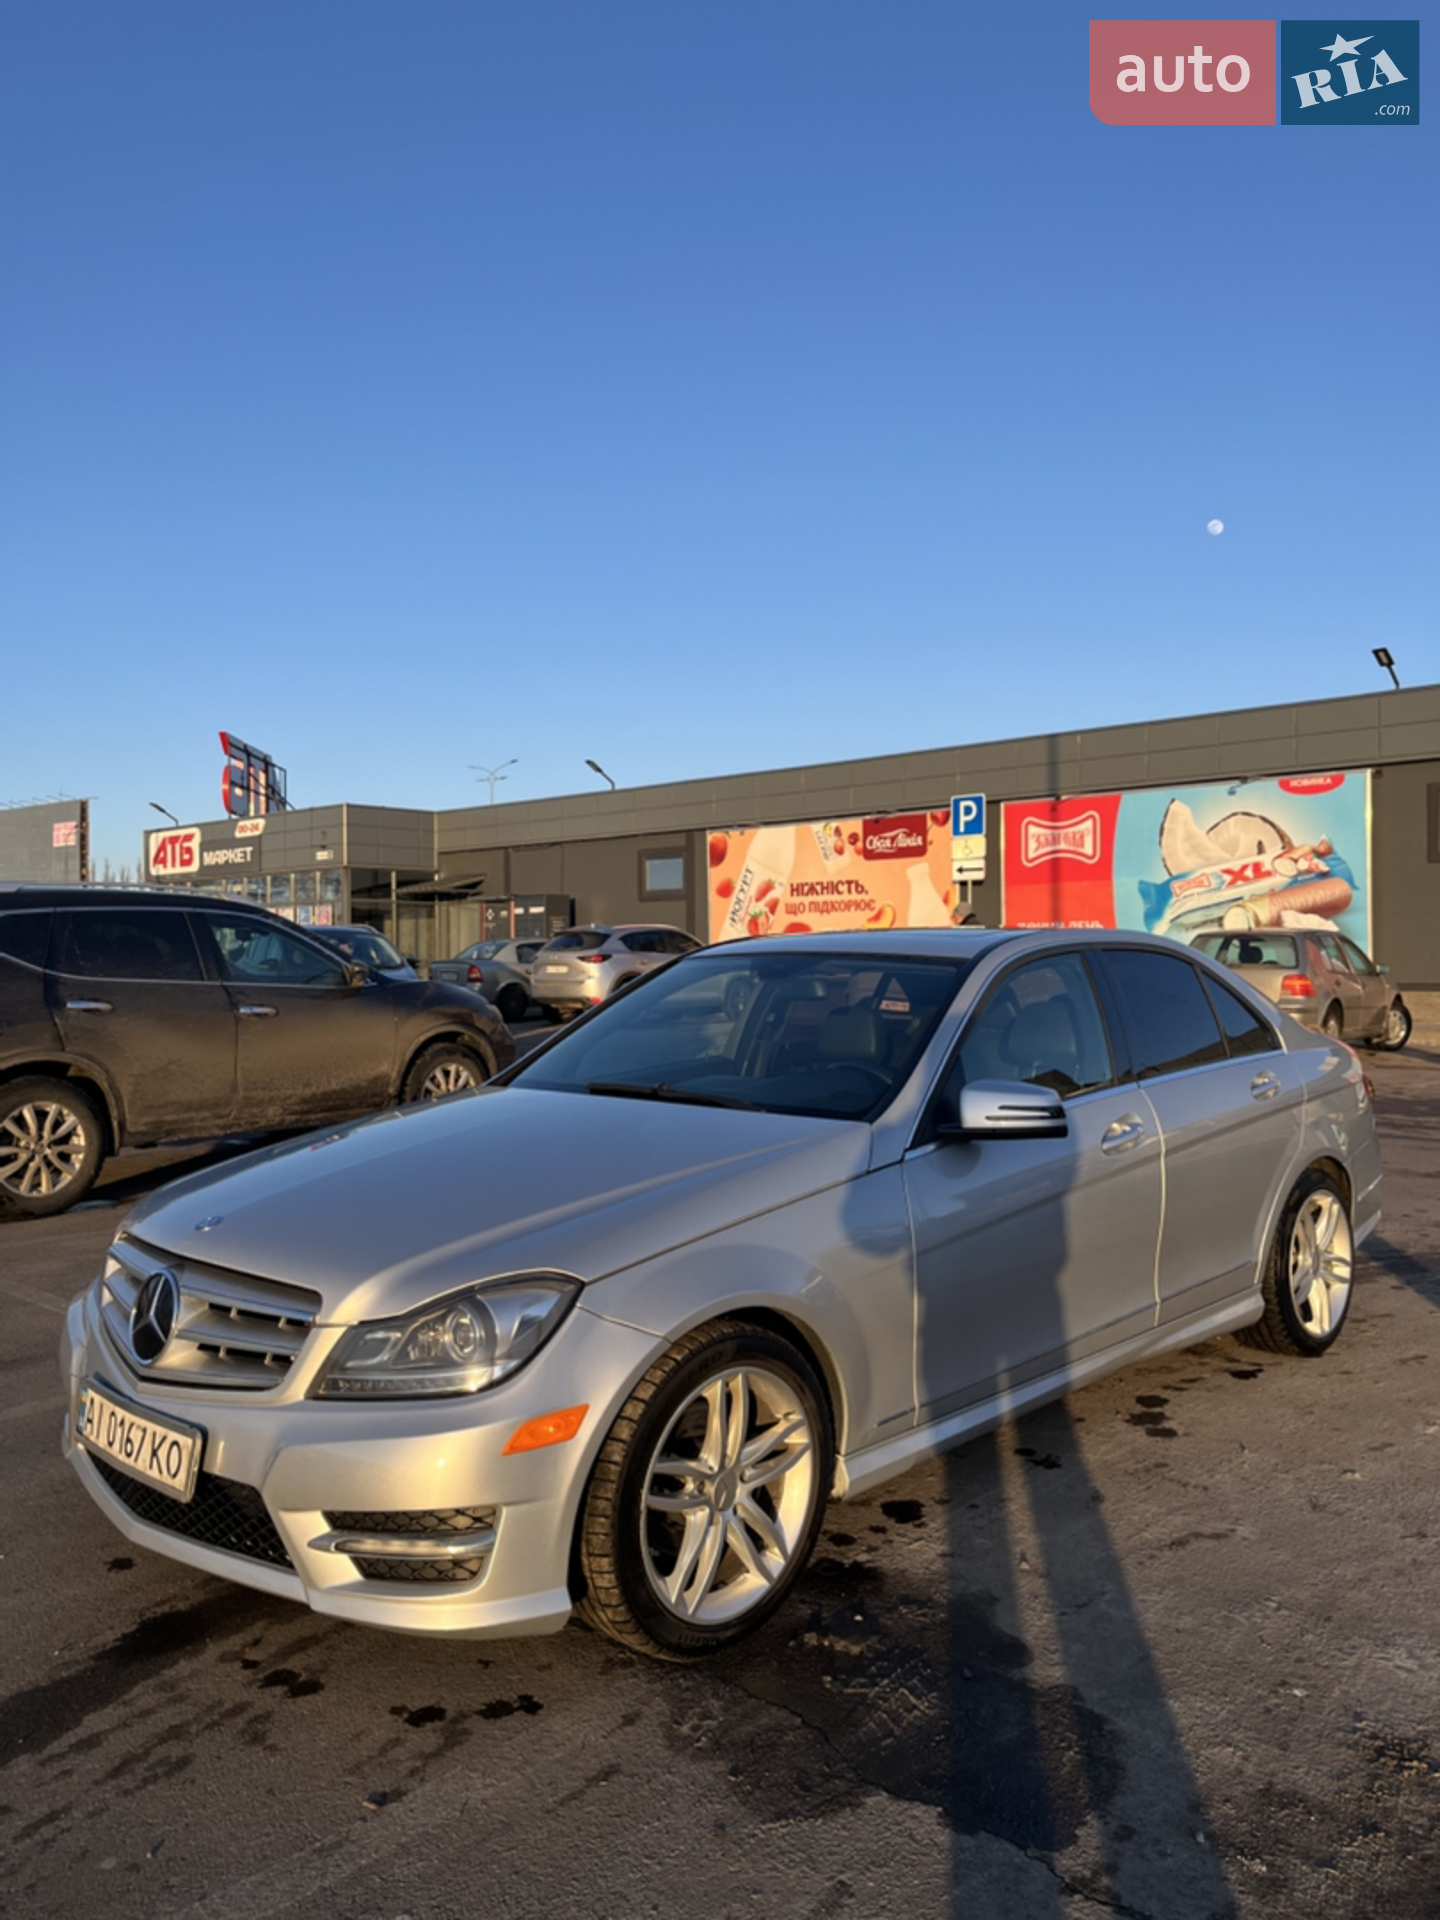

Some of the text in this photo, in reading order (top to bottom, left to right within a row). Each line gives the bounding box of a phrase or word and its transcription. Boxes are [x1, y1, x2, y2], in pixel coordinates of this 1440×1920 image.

[958, 799, 978, 833] P
[152, 833, 195, 869] АТБ
[202, 846, 254, 866] МАРКЕТ
[1221, 861, 1274, 887] XL
[784, 898, 876, 916] ЩО ПІДКОРЮЄ
[106, 1411, 147, 1463] 0167
[149, 1430, 182, 1480] KO
